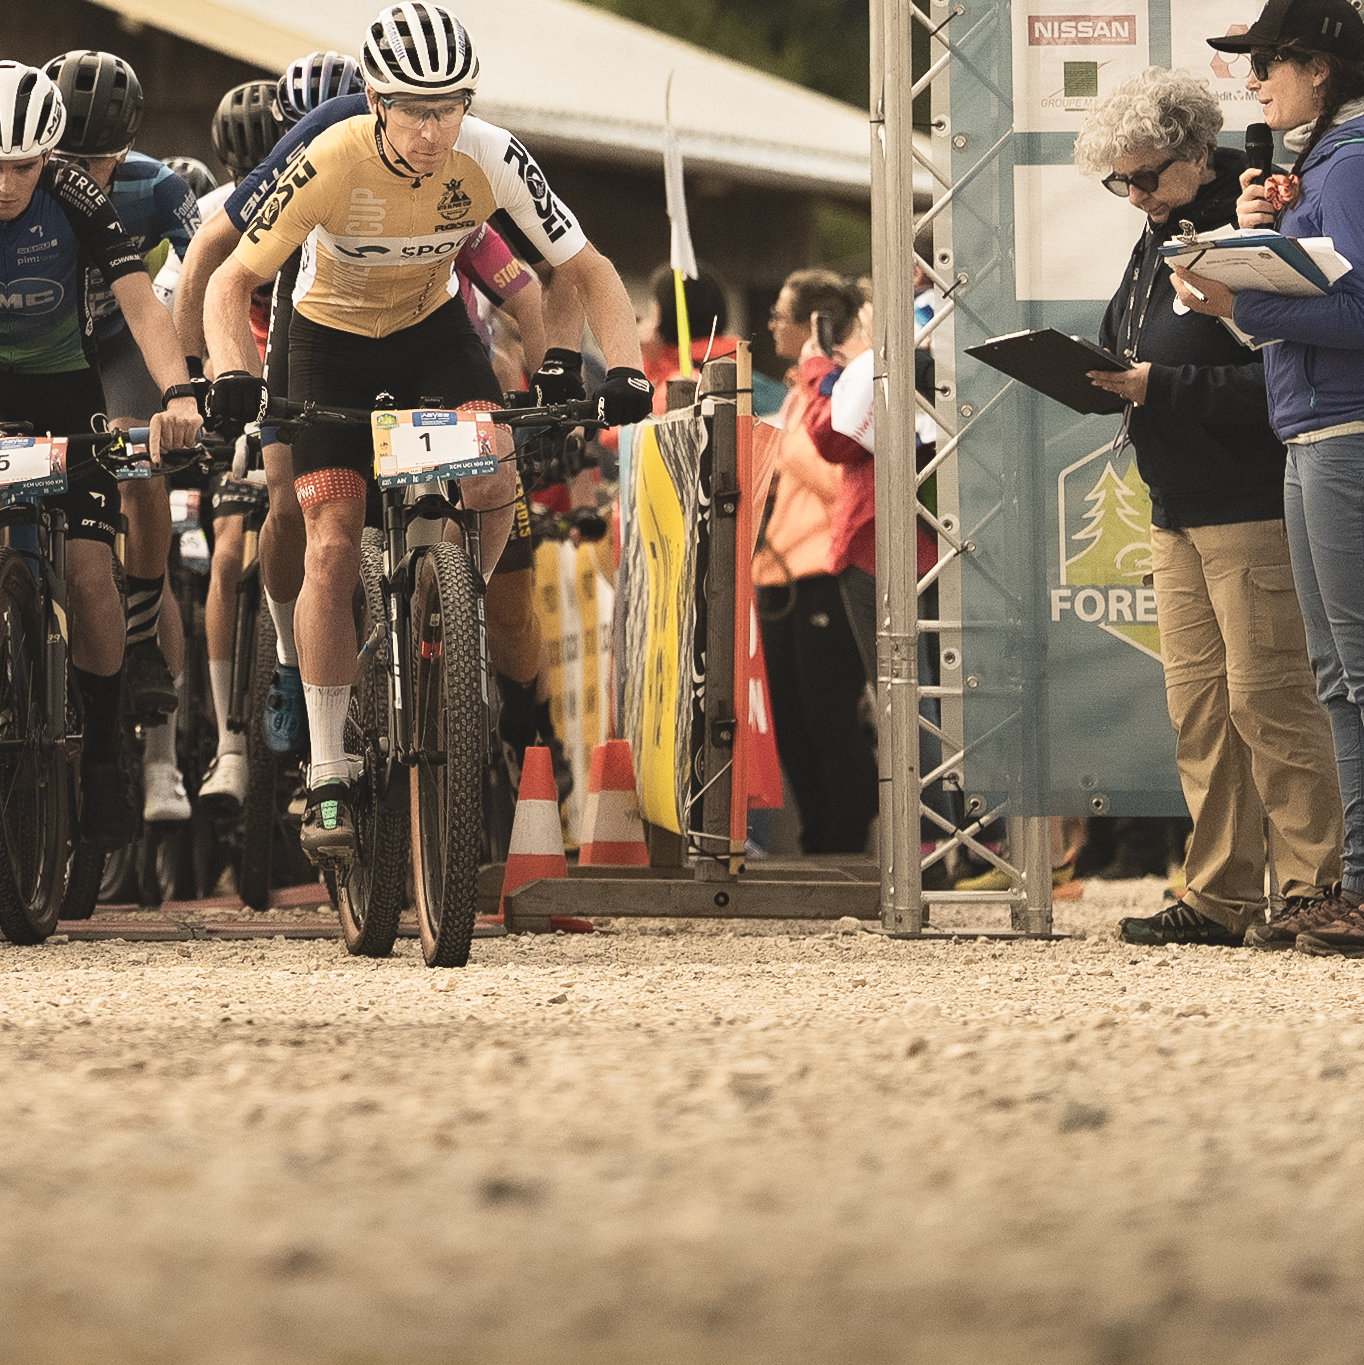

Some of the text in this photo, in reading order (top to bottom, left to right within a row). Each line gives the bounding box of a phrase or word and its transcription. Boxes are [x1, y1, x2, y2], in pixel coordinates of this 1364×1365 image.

[1034, 20, 1130, 39] NISSAN
[68, 169, 107, 207] TRUE
[345, 186, 388, 236] CUP
[418, 432, 432, 452] 1
